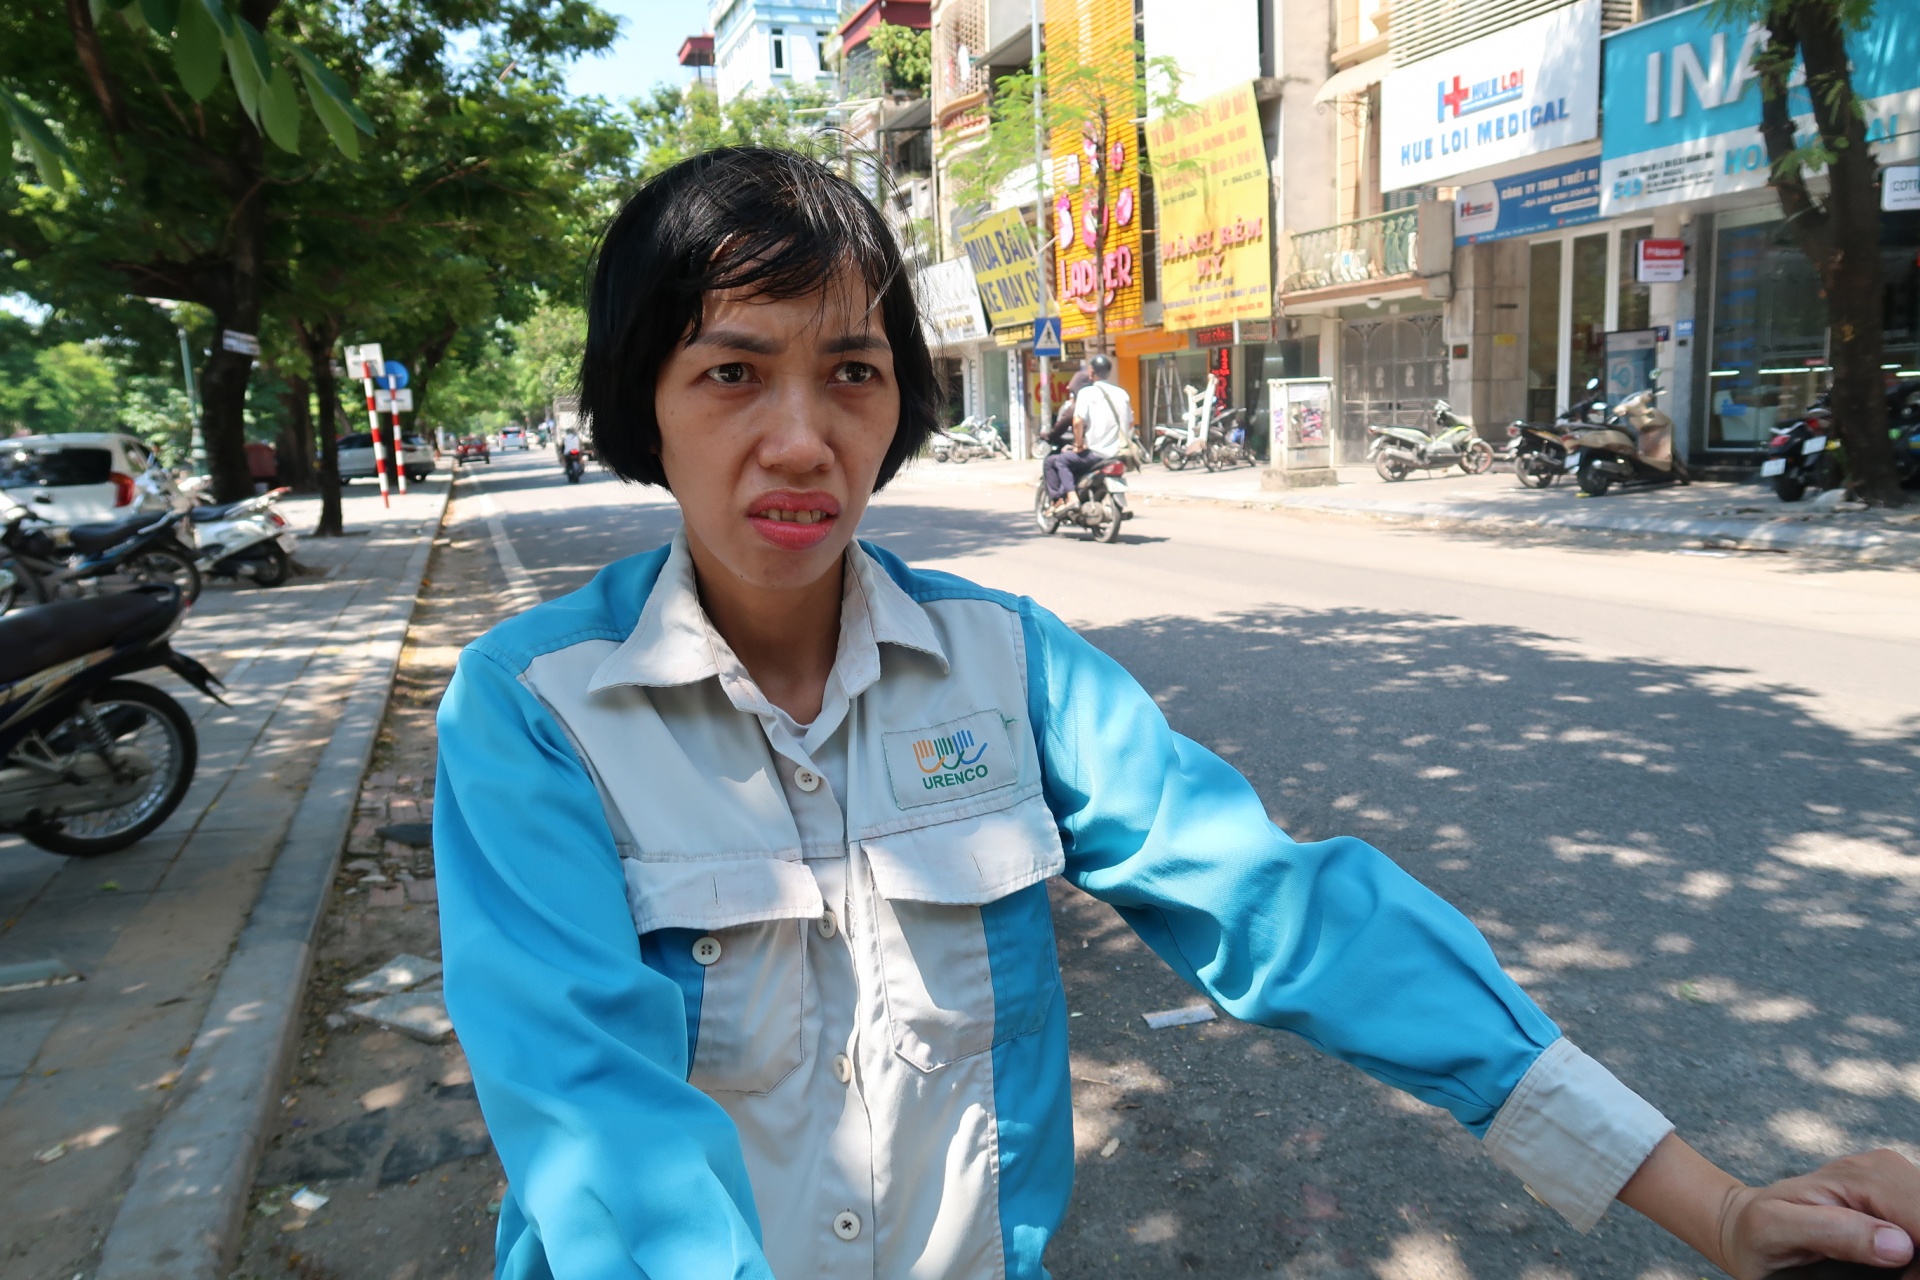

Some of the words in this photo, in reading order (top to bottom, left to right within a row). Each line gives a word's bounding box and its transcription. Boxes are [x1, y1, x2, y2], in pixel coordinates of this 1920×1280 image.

[1502, 68, 1524, 91] LOI
[1646, 22, 1853, 123] INA
[1402, 138, 1433, 166] HUE
[1441, 127, 1468, 155] LOI
[1478, 97, 1570, 145] MEDICAL
[964, 234, 1002, 274] MUA
[979, 281, 1003, 314] XE
[922, 764, 989, 790] URENCO
